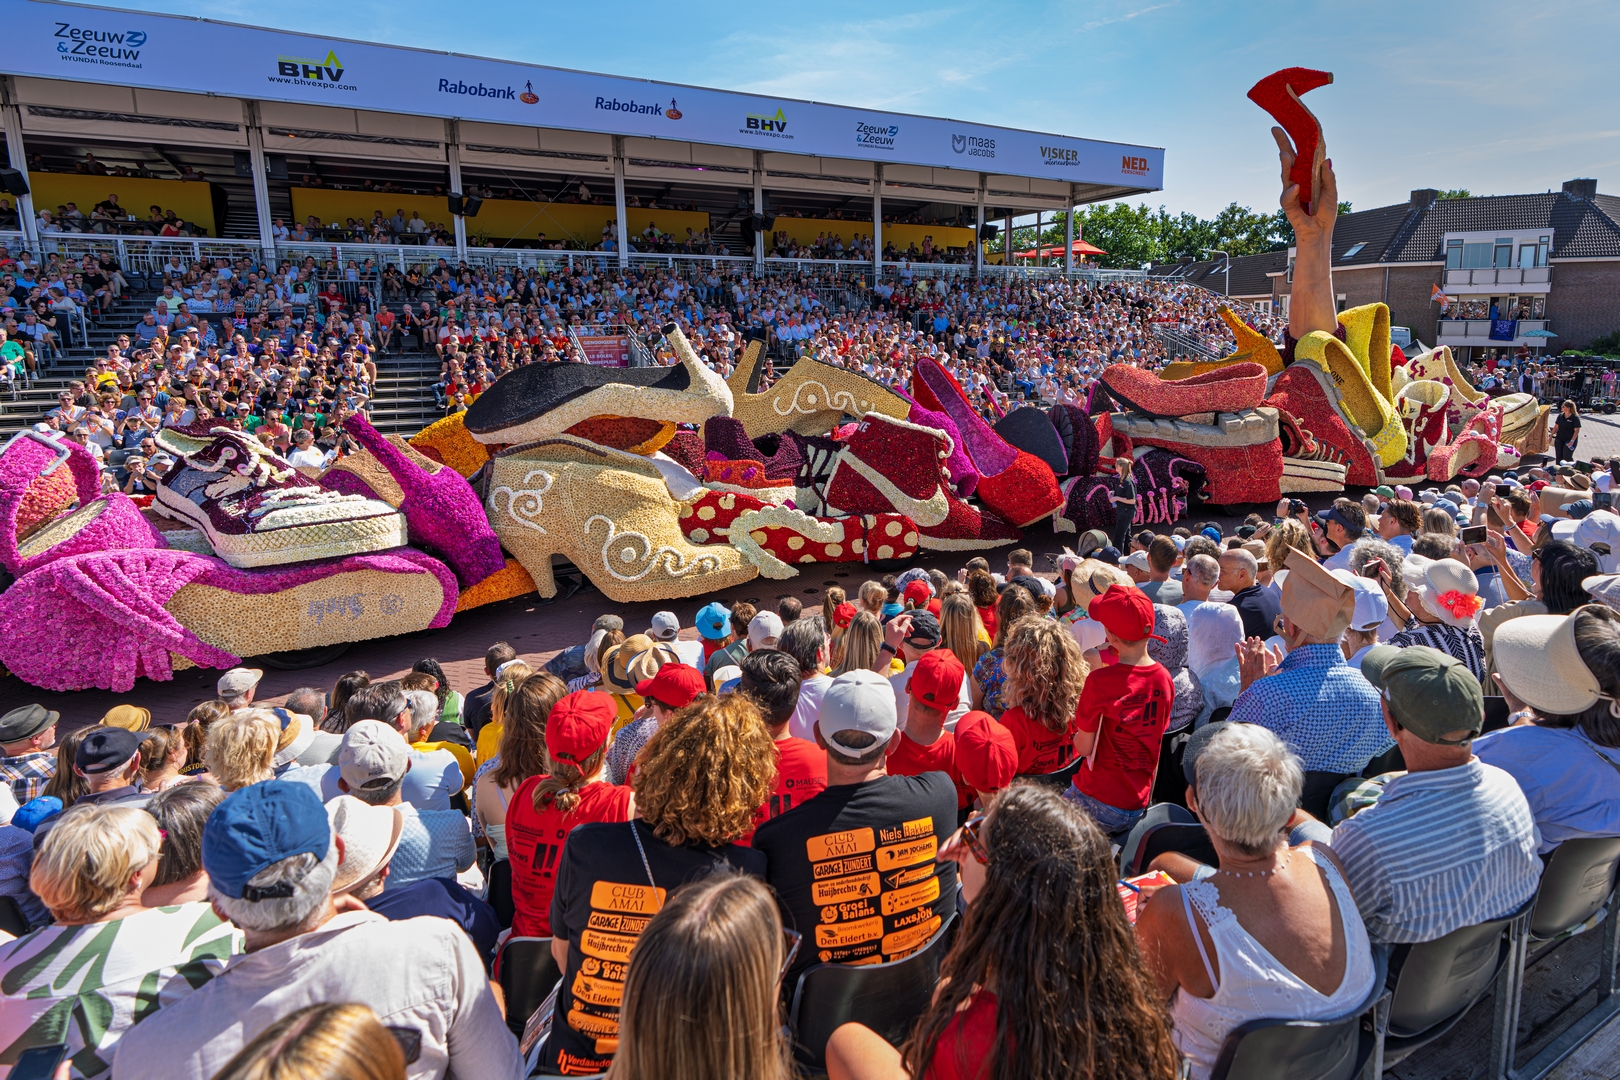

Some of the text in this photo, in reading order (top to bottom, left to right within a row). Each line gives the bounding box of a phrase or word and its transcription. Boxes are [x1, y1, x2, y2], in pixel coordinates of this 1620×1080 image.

[54, 22, 124, 44] Zeeuw
[61, 55, 142, 69] HYUNDAI Roosendaal
[278, 61, 344, 82] BHV
[268, 76, 357, 91] www.bhvexpo.com
[438, 78, 515, 100] Rabobank
[595, 96, 662, 116] Rabobank
[746, 117, 787, 132] BHV
[856, 122, 889, 135] Zeeuw
[739, 128, 794, 140] www.bhvexpo.com
[968, 136, 996, 149] maas
[1040, 146, 1079, 161] VISKER
[1122, 156, 1150, 171] NED.
[880, 827, 902, 842] Niels
[897, 848, 908, 857] JAN
[815, 857, 872, 876] GARAGE ZUNDERT
[818, 885, 857, 898] Huijbrechts
[842, 906, 875, 920] Balans
[590, 915, 649, 932] GARAGE ZUNDER
[838, 919, 879, 933] Boomkwekerij
[587, 939, 628, 953] Huijbrechts
[821, 937, 838, 945] Den
[840, 934, 865, 943] Eldert
[602, 961, 628, 972] Groe
[602, 969, 626, 980] Bala
[576, 985, 621, 1004] Den Eldert
[568, 1053, 614, 1068] Verdaasdo
